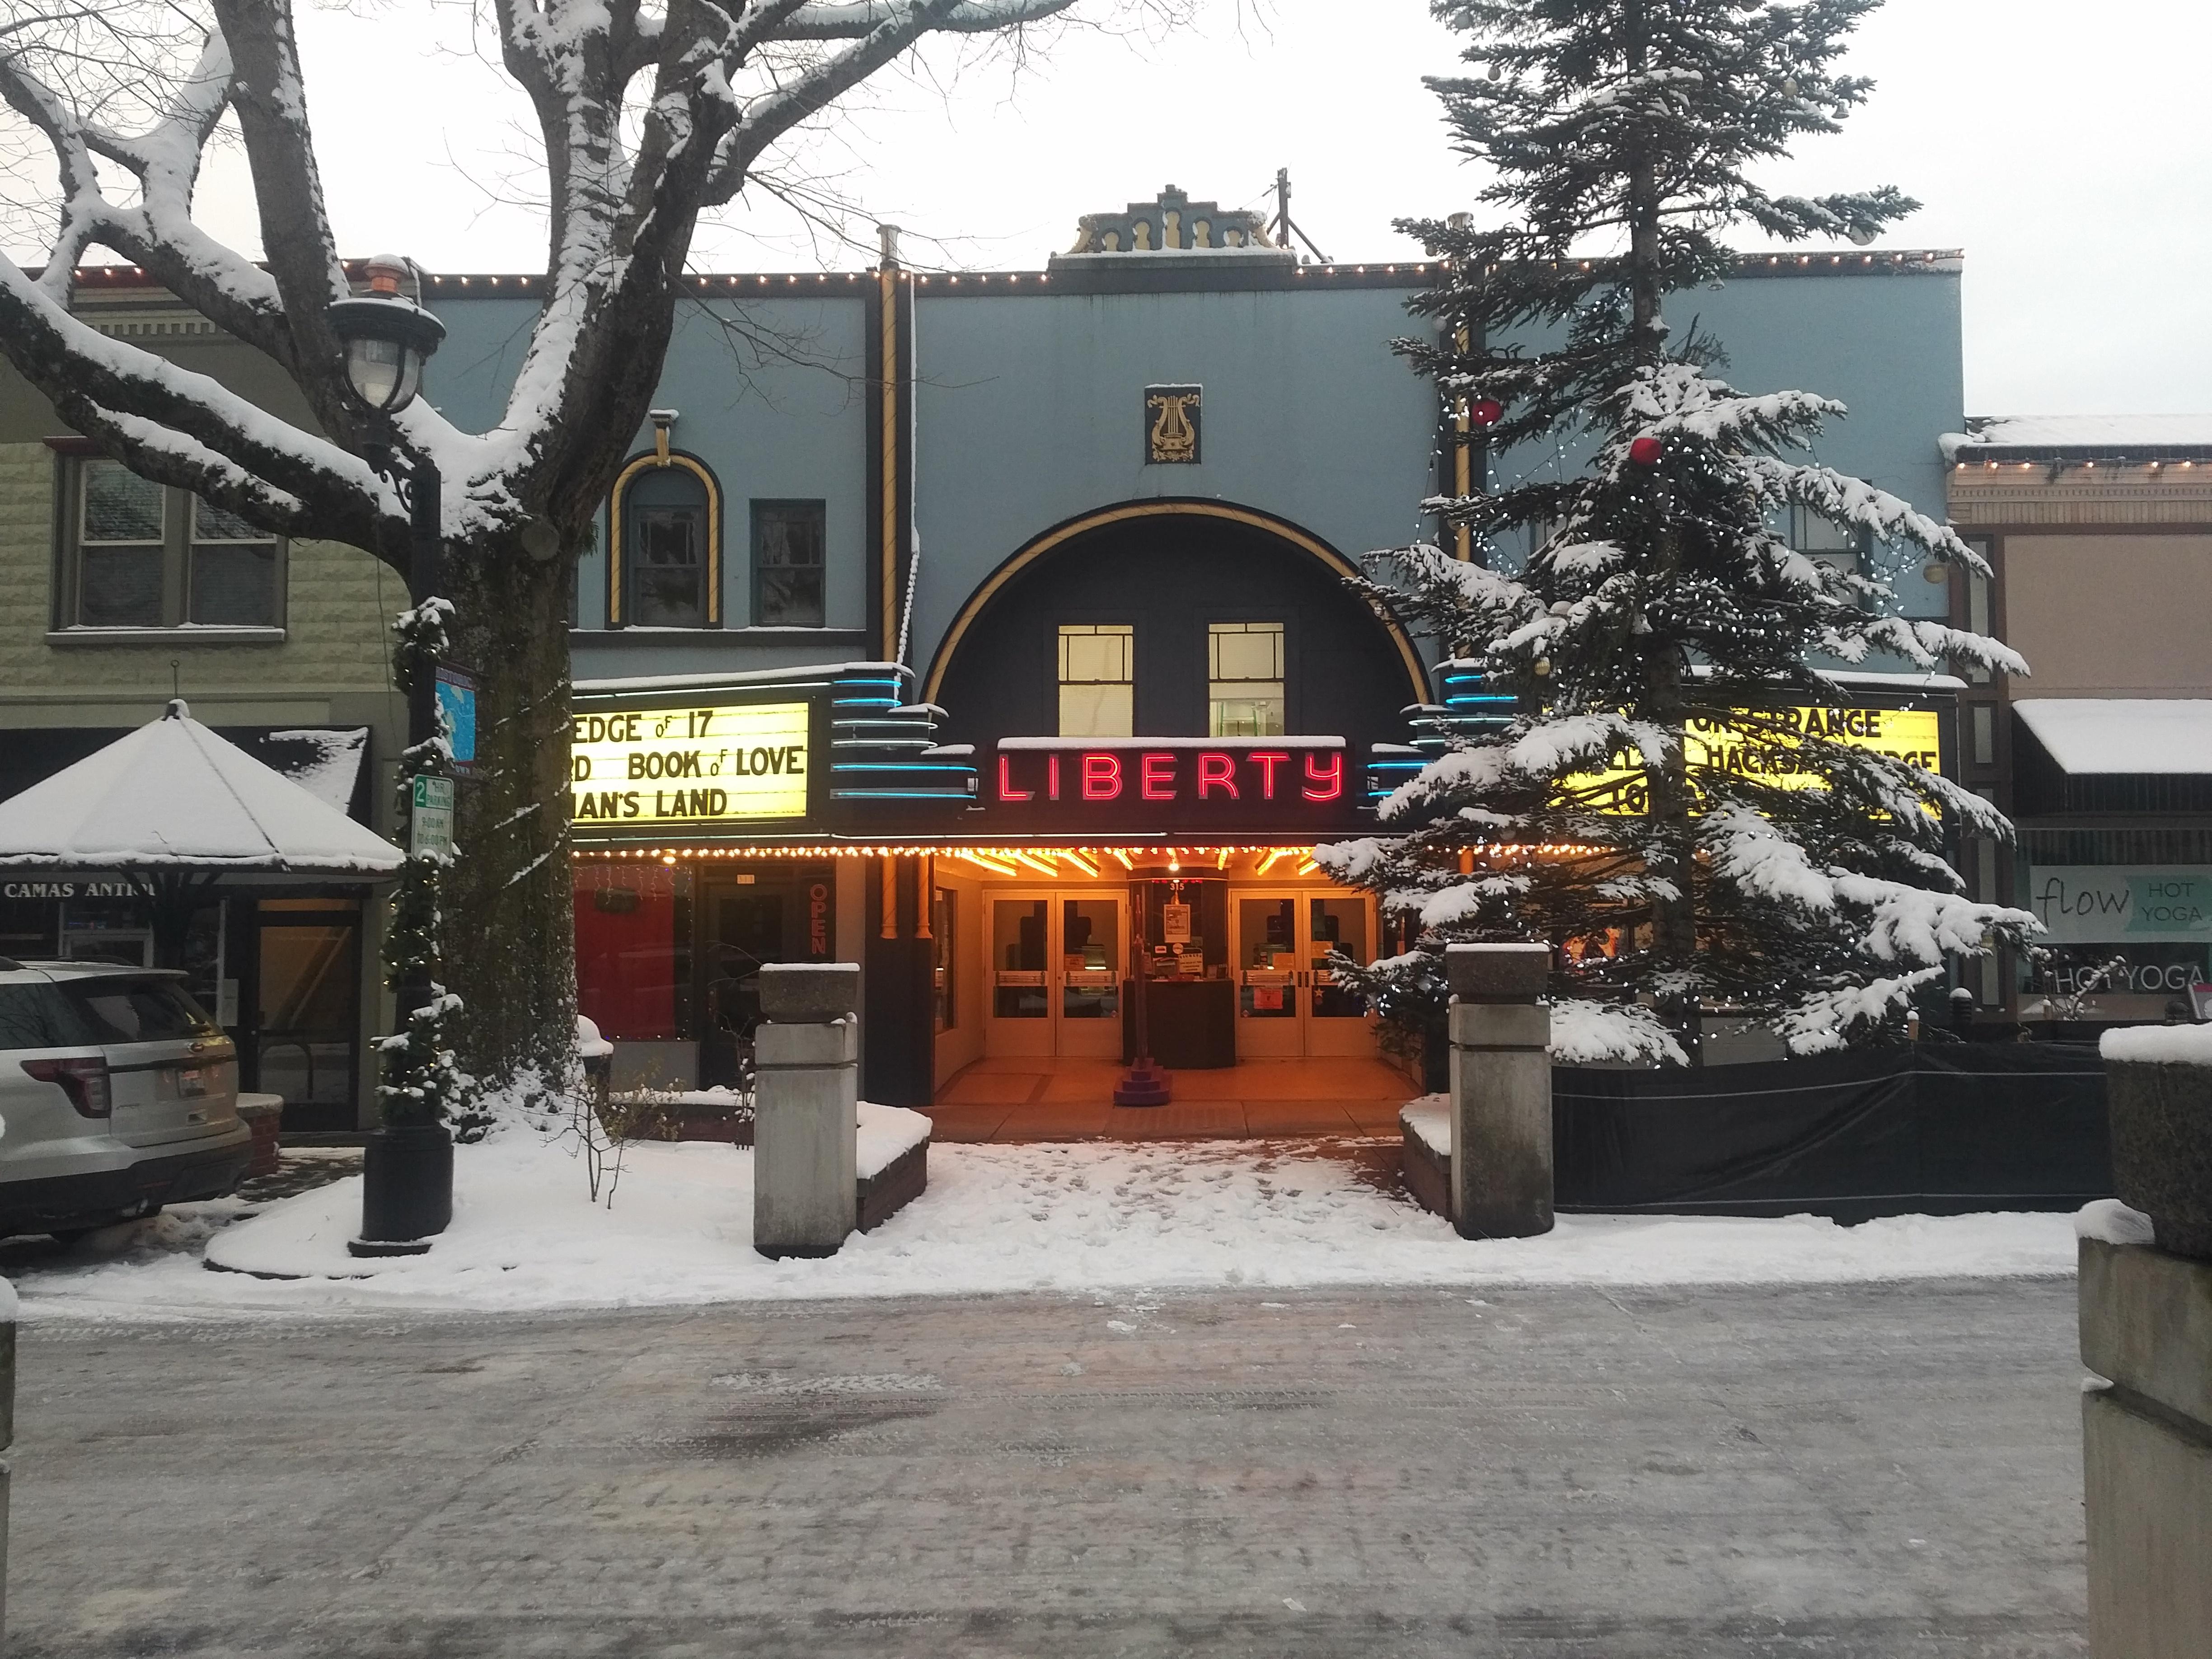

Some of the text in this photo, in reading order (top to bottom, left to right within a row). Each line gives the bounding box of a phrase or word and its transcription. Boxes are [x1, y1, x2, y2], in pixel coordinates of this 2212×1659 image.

[573, 714, 642, 743] EDGE
[689, 711, 713, 738] 17
[628, 750, 701, 779] BOOK
[736, 745, 804, 775] LOVE
[999, 752, 1342, 800] LIBERTY
[416, 782, 425, 802] 2
[572, 788, 727, 819] AN'S LAND
[4, 883, 75, 898] CAMAS
[2036, 877, 2130, 928] flow
[2148, 882, 2194, 897] HOT
[810, 884, 827, 954] OPEN
[2142, 906, 2203, 921] YOGA
[2120, 965, 2205, 990] YOGA
